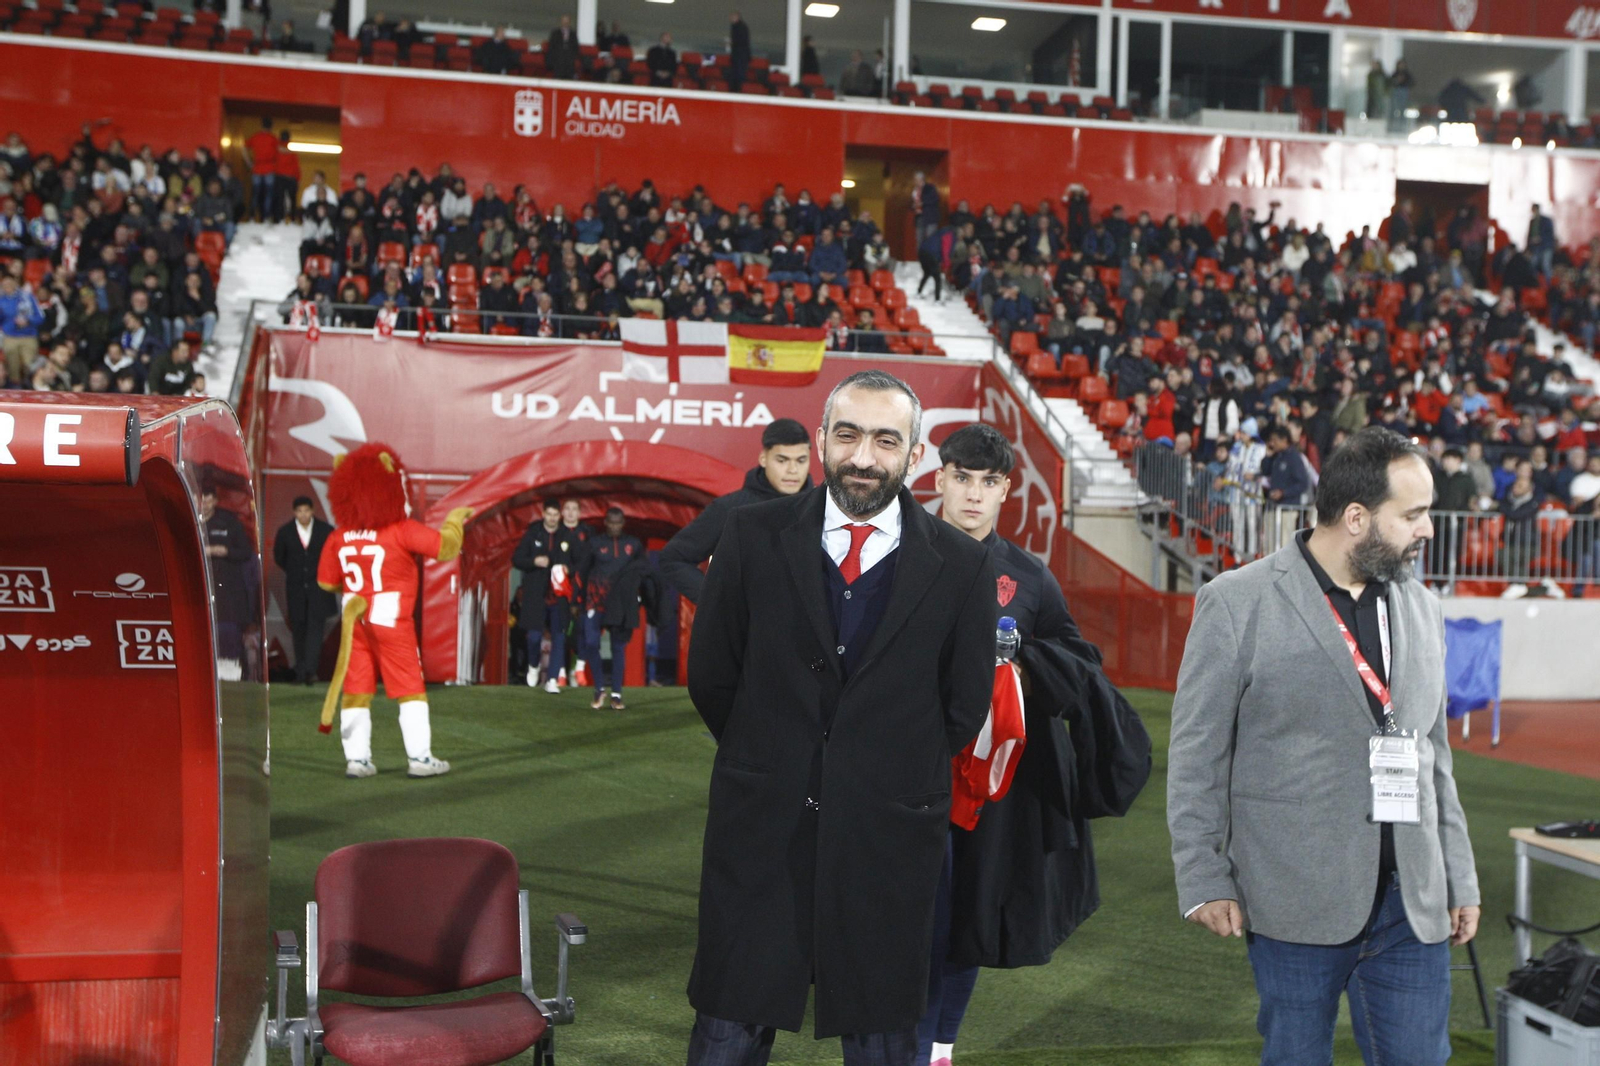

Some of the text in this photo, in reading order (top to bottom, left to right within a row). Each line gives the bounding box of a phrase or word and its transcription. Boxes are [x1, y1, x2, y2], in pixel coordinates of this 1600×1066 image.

[565, 96, 681, 126] ALMERÍA
[564, 120, 626, 139] CIUDAD
[491, 391, 776, 428] UD ALMERÍA
[338, 545, 386, 592] 57
